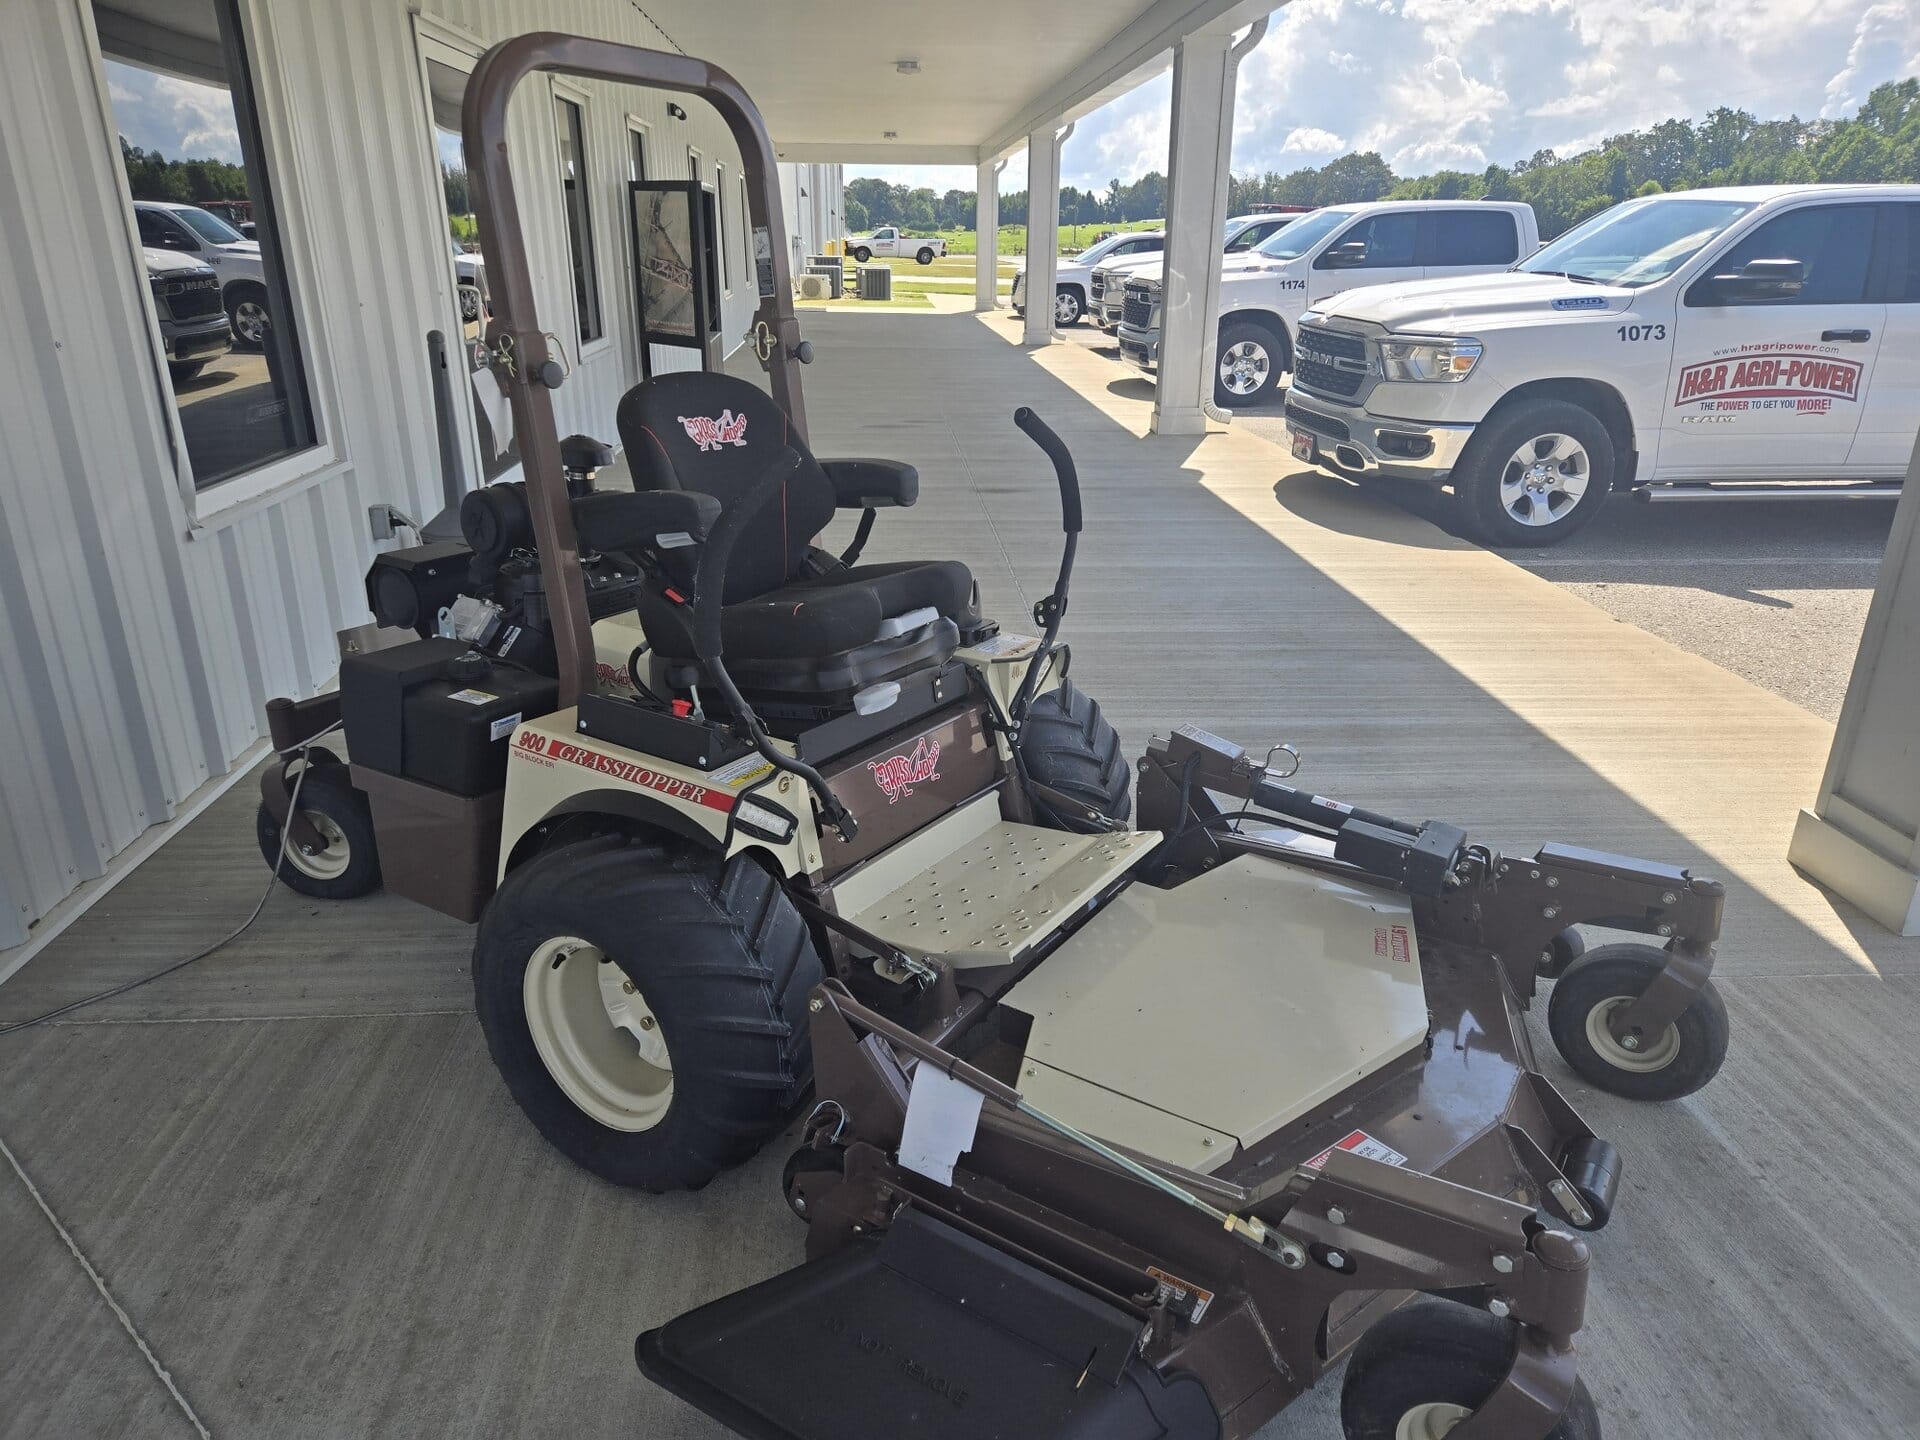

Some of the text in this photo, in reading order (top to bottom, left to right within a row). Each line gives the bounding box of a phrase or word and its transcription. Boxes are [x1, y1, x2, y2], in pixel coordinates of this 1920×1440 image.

[1279, 280, 1306, 290] 1174
[1617, 324, 1667, 341] 1073
[1713, 342, 1840, 356] www.hragripower.com
[1300, 348, 1333, 366] RAM
[1682, 360, 1857, 399] H&R AGRI-POWER
[1700, 398, 1832, 411] THE POWER TO GET YOU MORE!
[1681, 415, 1736, 424] RAM
[519, 730, 547, 752] 900
[524, 753, 545, 766] BLOCK
[559, 744, 707, 804] GRASSHOPPER
